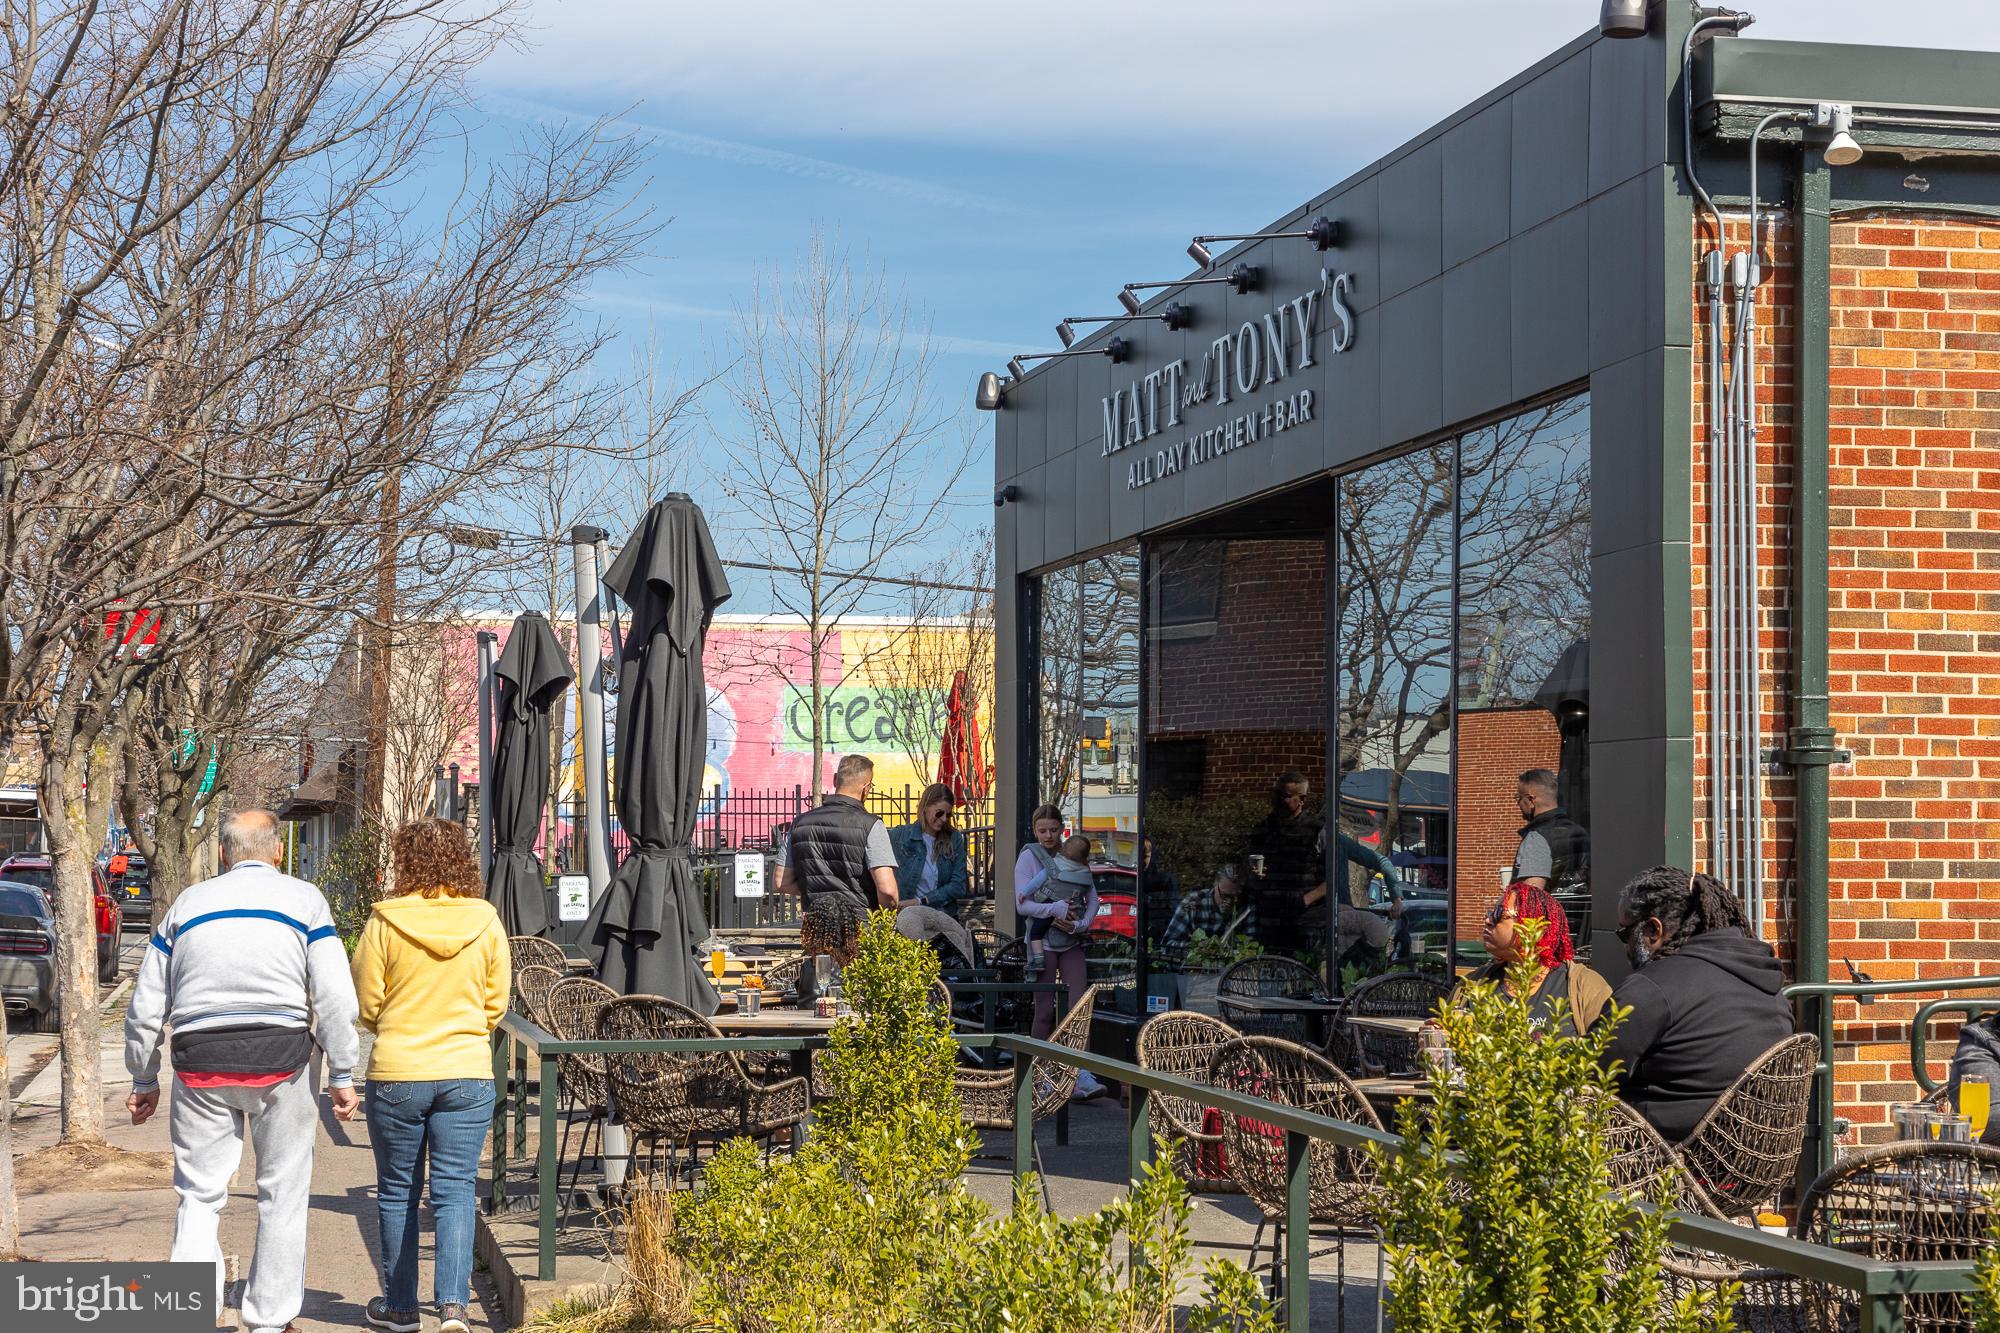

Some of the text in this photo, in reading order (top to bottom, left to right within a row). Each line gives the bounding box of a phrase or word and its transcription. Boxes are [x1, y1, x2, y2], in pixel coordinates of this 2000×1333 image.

[1101, 267, 1351, 457] MATT and TONY'S
[1128, 457, 1153, 491] ALL
[1157, 441, 1187, 478] DAY
[1189, 411, 1258, 466] KITCHEN
[1275, 389, 1313, 432] BAR
